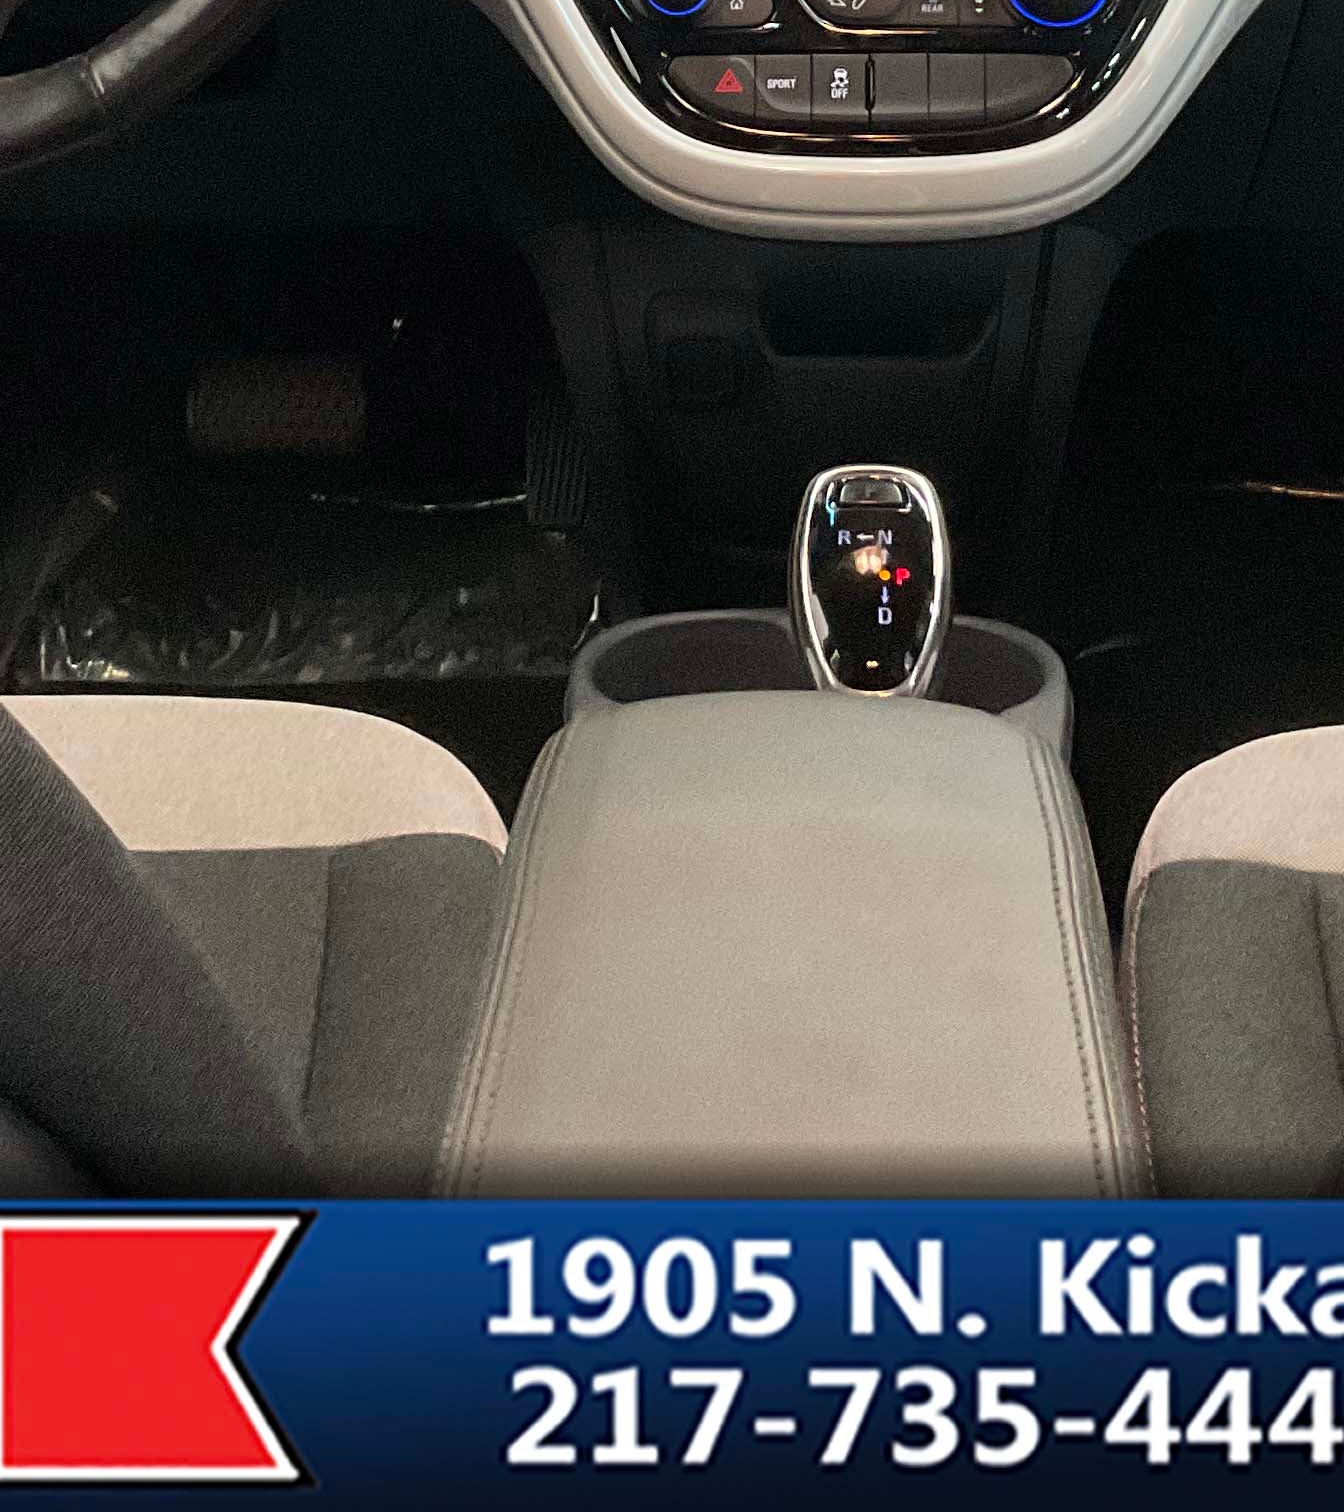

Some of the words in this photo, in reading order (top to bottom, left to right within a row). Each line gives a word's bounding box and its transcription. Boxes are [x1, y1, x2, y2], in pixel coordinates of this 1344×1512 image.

[921, 3, 944, 13] REAR
[766, 78, 797, 90] SPORT
[830, 87, 848, 99] OFF
[837, 530, 851, 545] R
[877, 530, 892, 545] N
[894, 567, 910, 585] P
[877, 607, 893, 625] D
